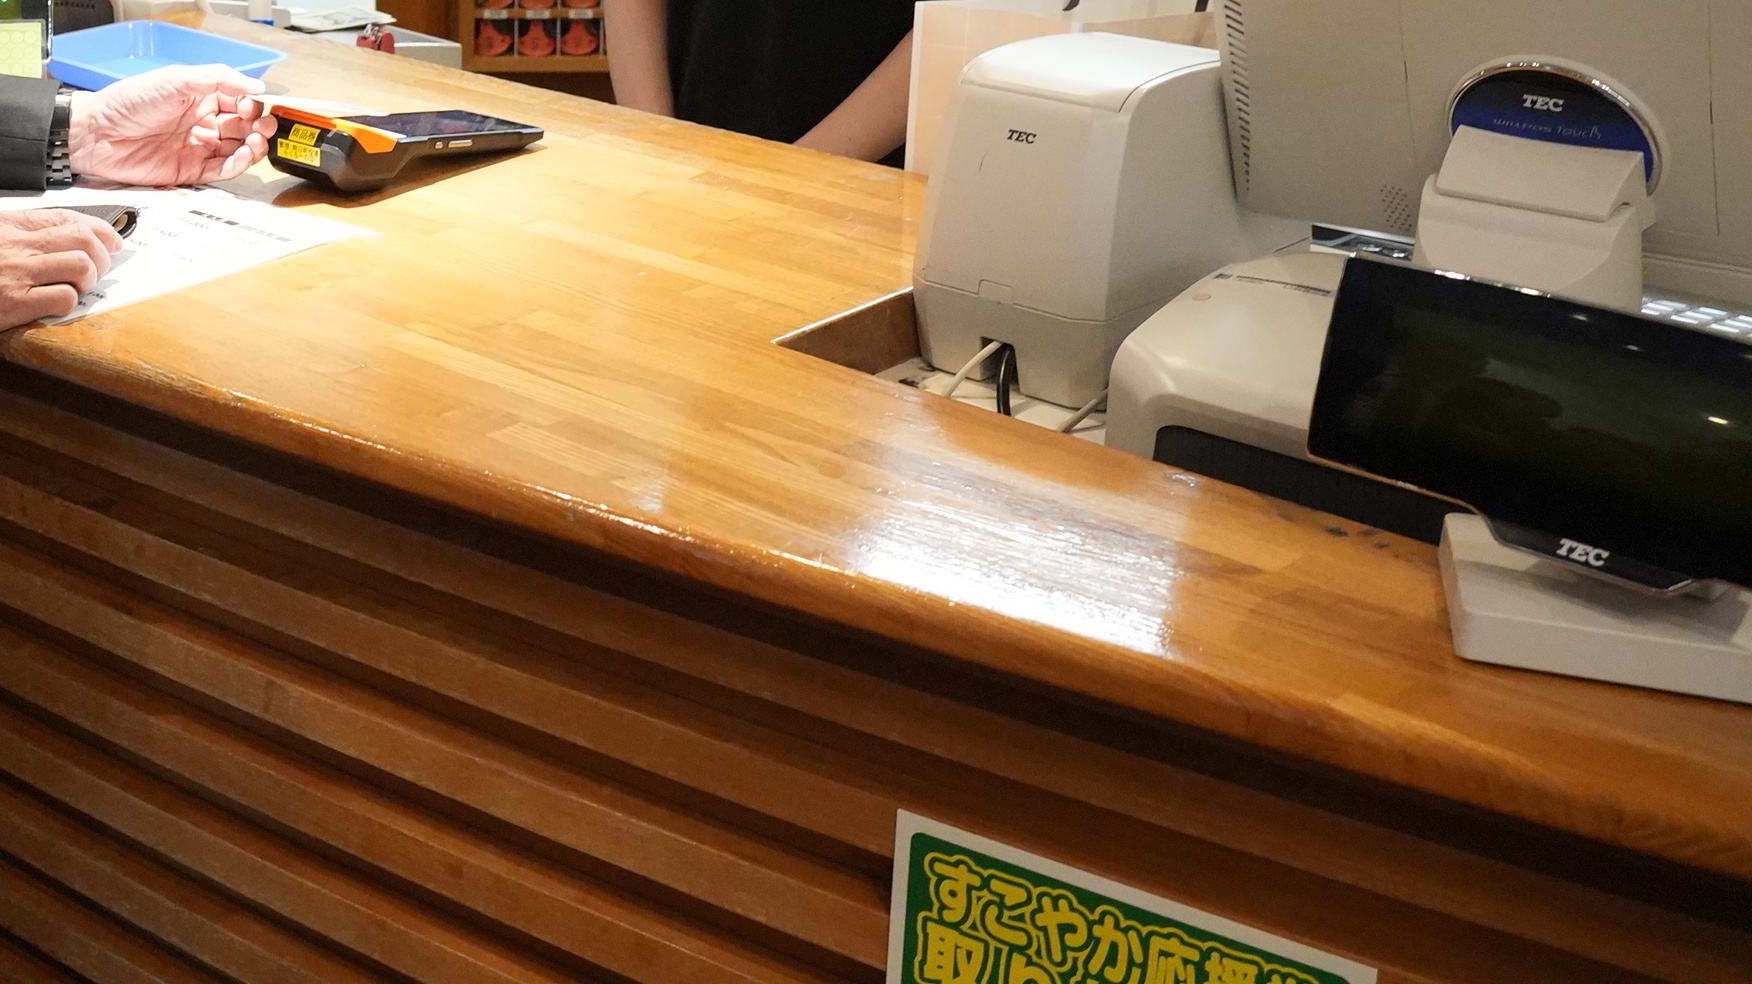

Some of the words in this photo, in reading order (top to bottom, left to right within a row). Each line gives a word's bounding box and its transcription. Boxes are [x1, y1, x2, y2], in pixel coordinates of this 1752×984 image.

[1522, 93, 1565, 113] TEC
[1007, 128, 1037, 144] TEC
[1555, 537, 1610, 567] TEC
